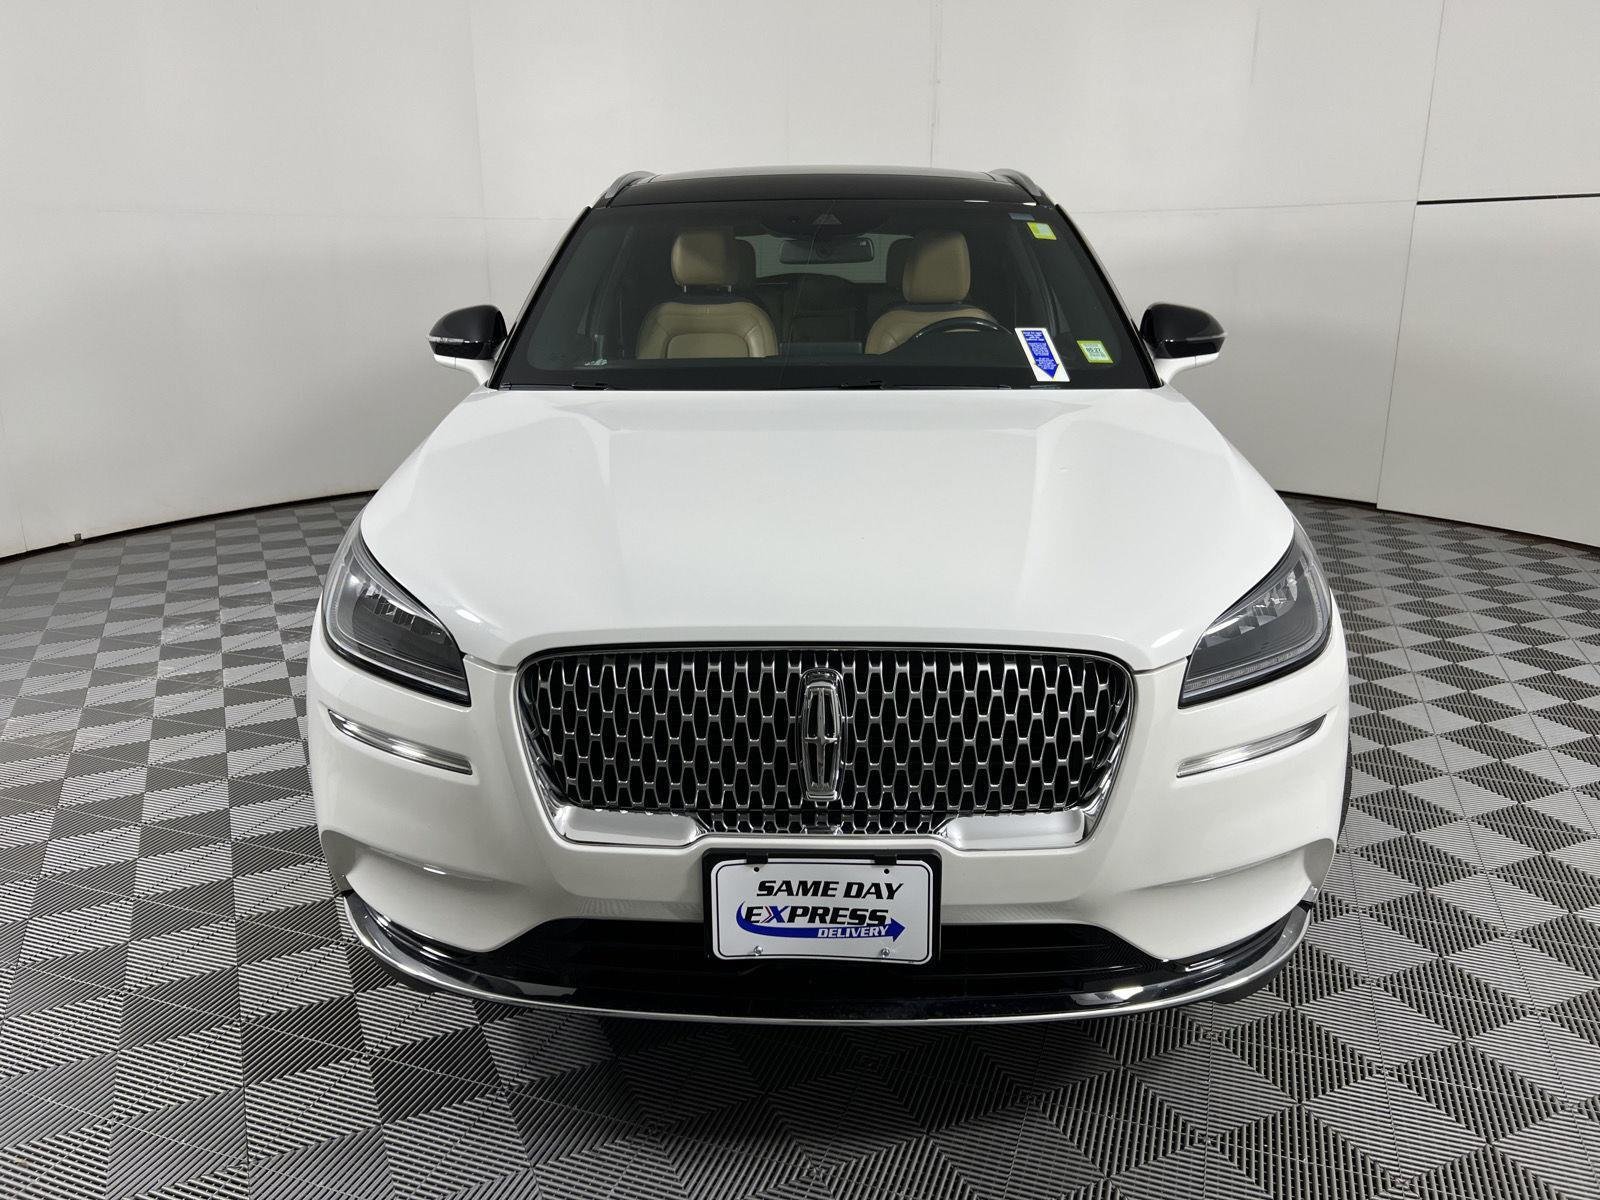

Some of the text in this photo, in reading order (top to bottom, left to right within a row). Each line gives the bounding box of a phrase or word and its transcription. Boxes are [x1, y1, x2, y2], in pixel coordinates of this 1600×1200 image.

[757, 880, 904, 900] SAME DAY
[745, 905, 889, 925] EXPRESS
[817, 926, 889, 938] DELIVERY
